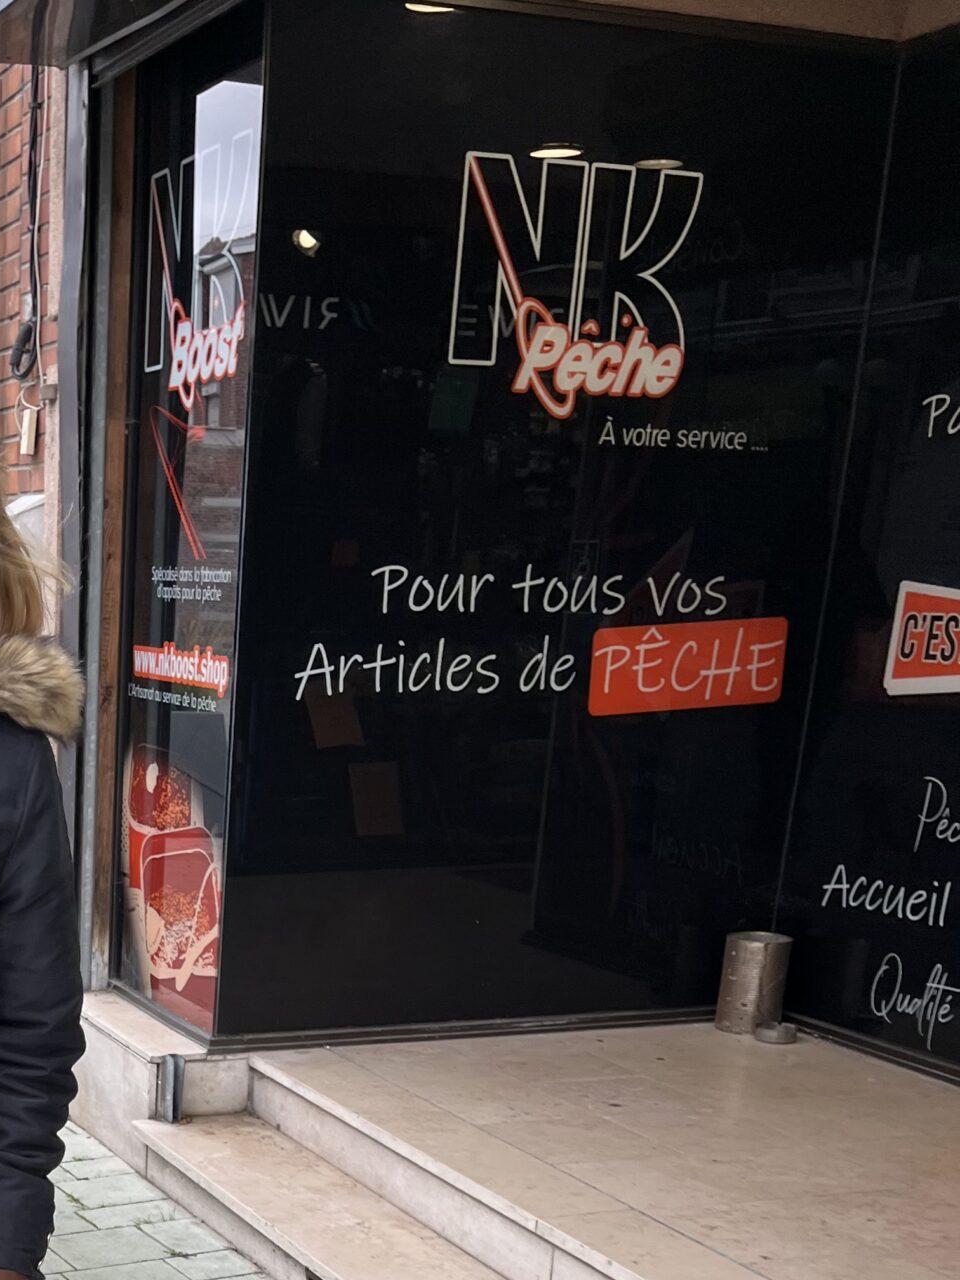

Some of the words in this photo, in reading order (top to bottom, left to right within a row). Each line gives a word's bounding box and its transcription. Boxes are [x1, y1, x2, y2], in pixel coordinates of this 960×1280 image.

[448, 151, 704, 366] NK
[169, 303, 246, 402] Boost
[511, 318, 685, 419] Pêche
[598, 415, 616, 446] À
[622, 423, 671, 447] votre
[676, 425, 748, 450] service
[178, 566, 193, 582] dans
[194, 566, 200, 582] la
[181, 588, 195, 603] pour
[195, 584, 202, 600] la
[201, 584, 222, 604] pêche
[371, 564, 495, 615] Pour
[511, 563, 626, 616] tous
[647, 571, 728, 616] vos
[133, 645, 228, 693] www.nkboost.shop
[294, 637, 500, 701] Articles
[519, 635, 577, 692] de
[594, 626, 785, 700] PÊCHE
[162, 690, 181, 706] service
[182, 692, 190, 707] de
[190, 692, 197, 709] la
[197, 695, 217, 713] pêche
[822, 864, 951, 927] Accueil
[870, 952, 960, 1051] Qualité
